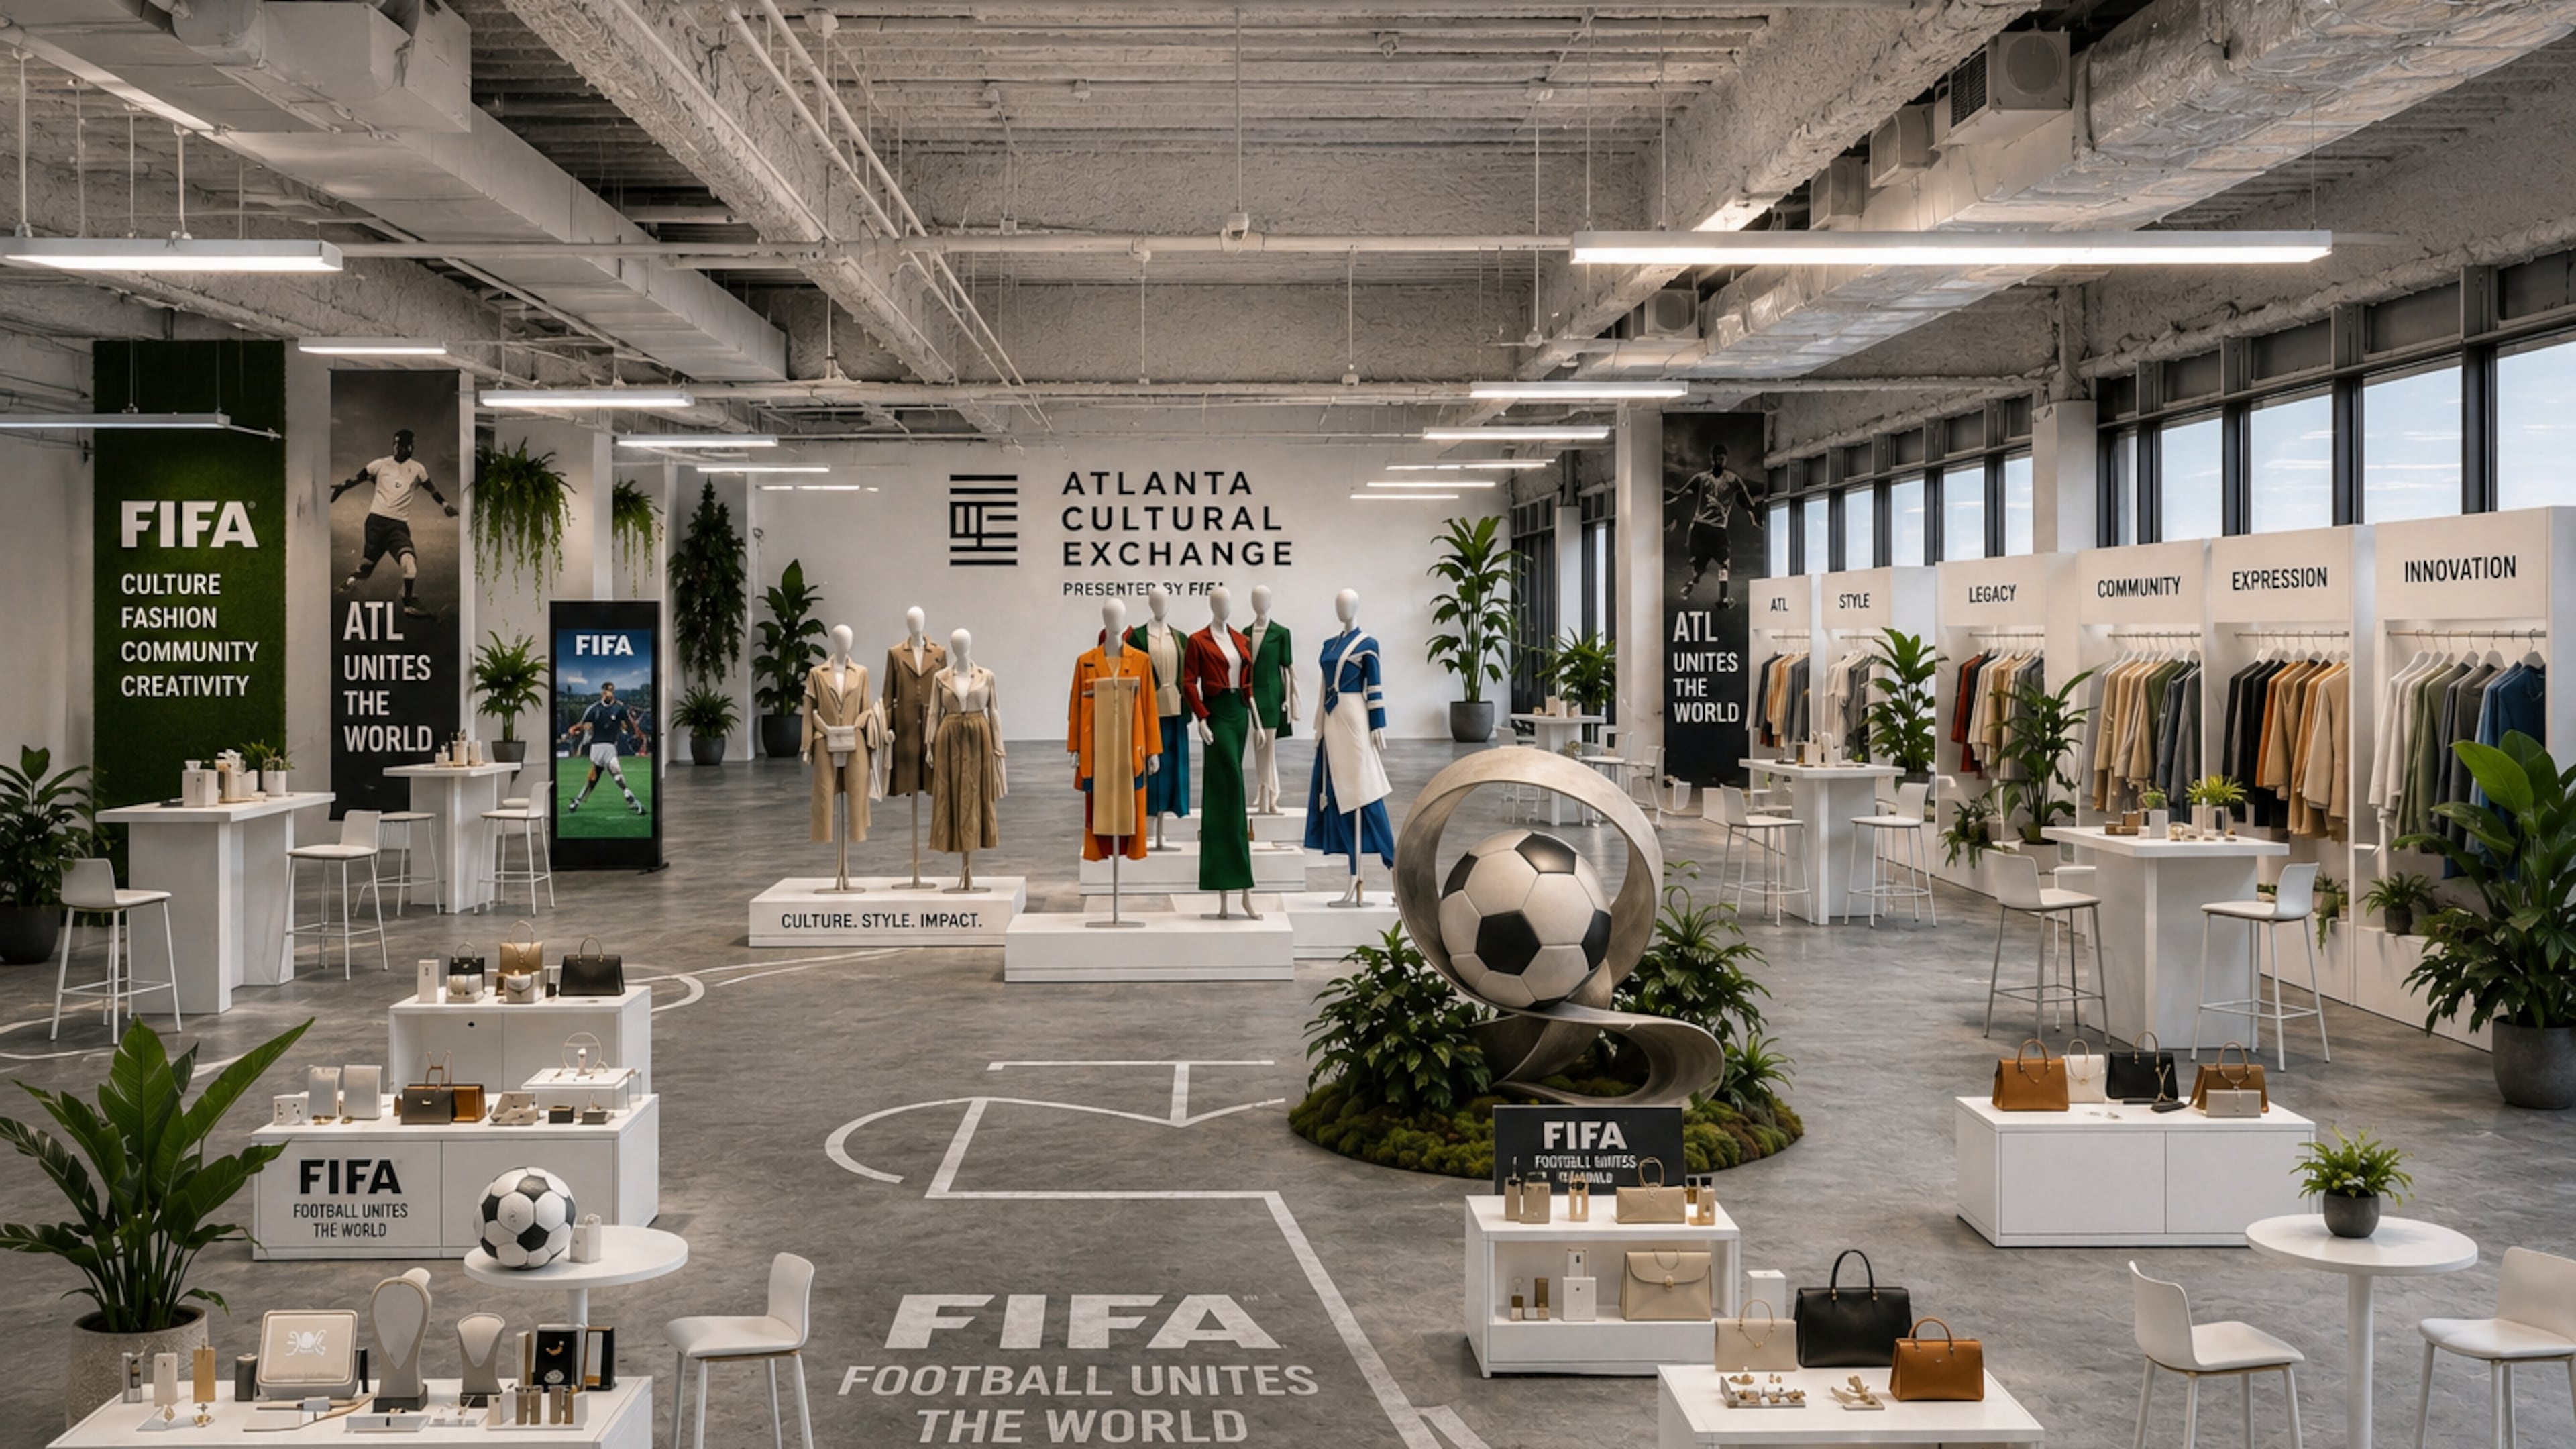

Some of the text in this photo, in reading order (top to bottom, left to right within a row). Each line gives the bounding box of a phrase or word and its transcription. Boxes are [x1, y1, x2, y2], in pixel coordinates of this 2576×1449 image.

[1062, 471, 1252, 495] ATLANTA
[121, 500, 258, 548] FIFA
[1061, 506, 1282, 531] CULTURAL
[1063, 541, 1292, 566] EXCHANGE
[2231, 566, 2328, 591] EXPRESSION
[2404, 555, 2517, 583] INNOVATION
[121, 573, 221, 596] CULTURE
[1189, 582, 1224, 596] FIF
[1968, 584, 2017, 604] LEGACY
[2097, 576, 2182, 598] COMMUNITY
[1770, 597, 1789, 612] ATL
[1839, 592, 1871, 610] STYLE
[121, 606, 217, 629] FASHION
[343, 601, 405, 641] ATL
[1673, 611, 1719, 643] ATL
[121, 641, 258, 663] COMMUNITY
[575, 634, 634, 656] FIFA
[343, 654, 431, 681] UNITES
[1674, 651, 1739, 673] UNITES
[121, 675, 249, 697] CREATIVITY
[1673, 678, 1708, 698] THE
[343, 690, 390, 716] THE
[1674, 702, 1739, 724] WORLD
[343, 724, 433, 753] WORLD
[781, 913, 983, 928] CULTURE. STYLE. IMPACT.
[1544, 1121, 1628, 1150] FIFA
[300, 1159, 402, 1195] FIFA
[293, 1203, 408, 1219] FOOTBALL UNITES
[313, 1222, 386, 1238] THE WORLD
[883, 1293, 1282, 1349] FIFA
[837, 1364, 1319, 1397] FOOTBALL UNITES
[916, 1409, 1248, 1444] THE WORLD
